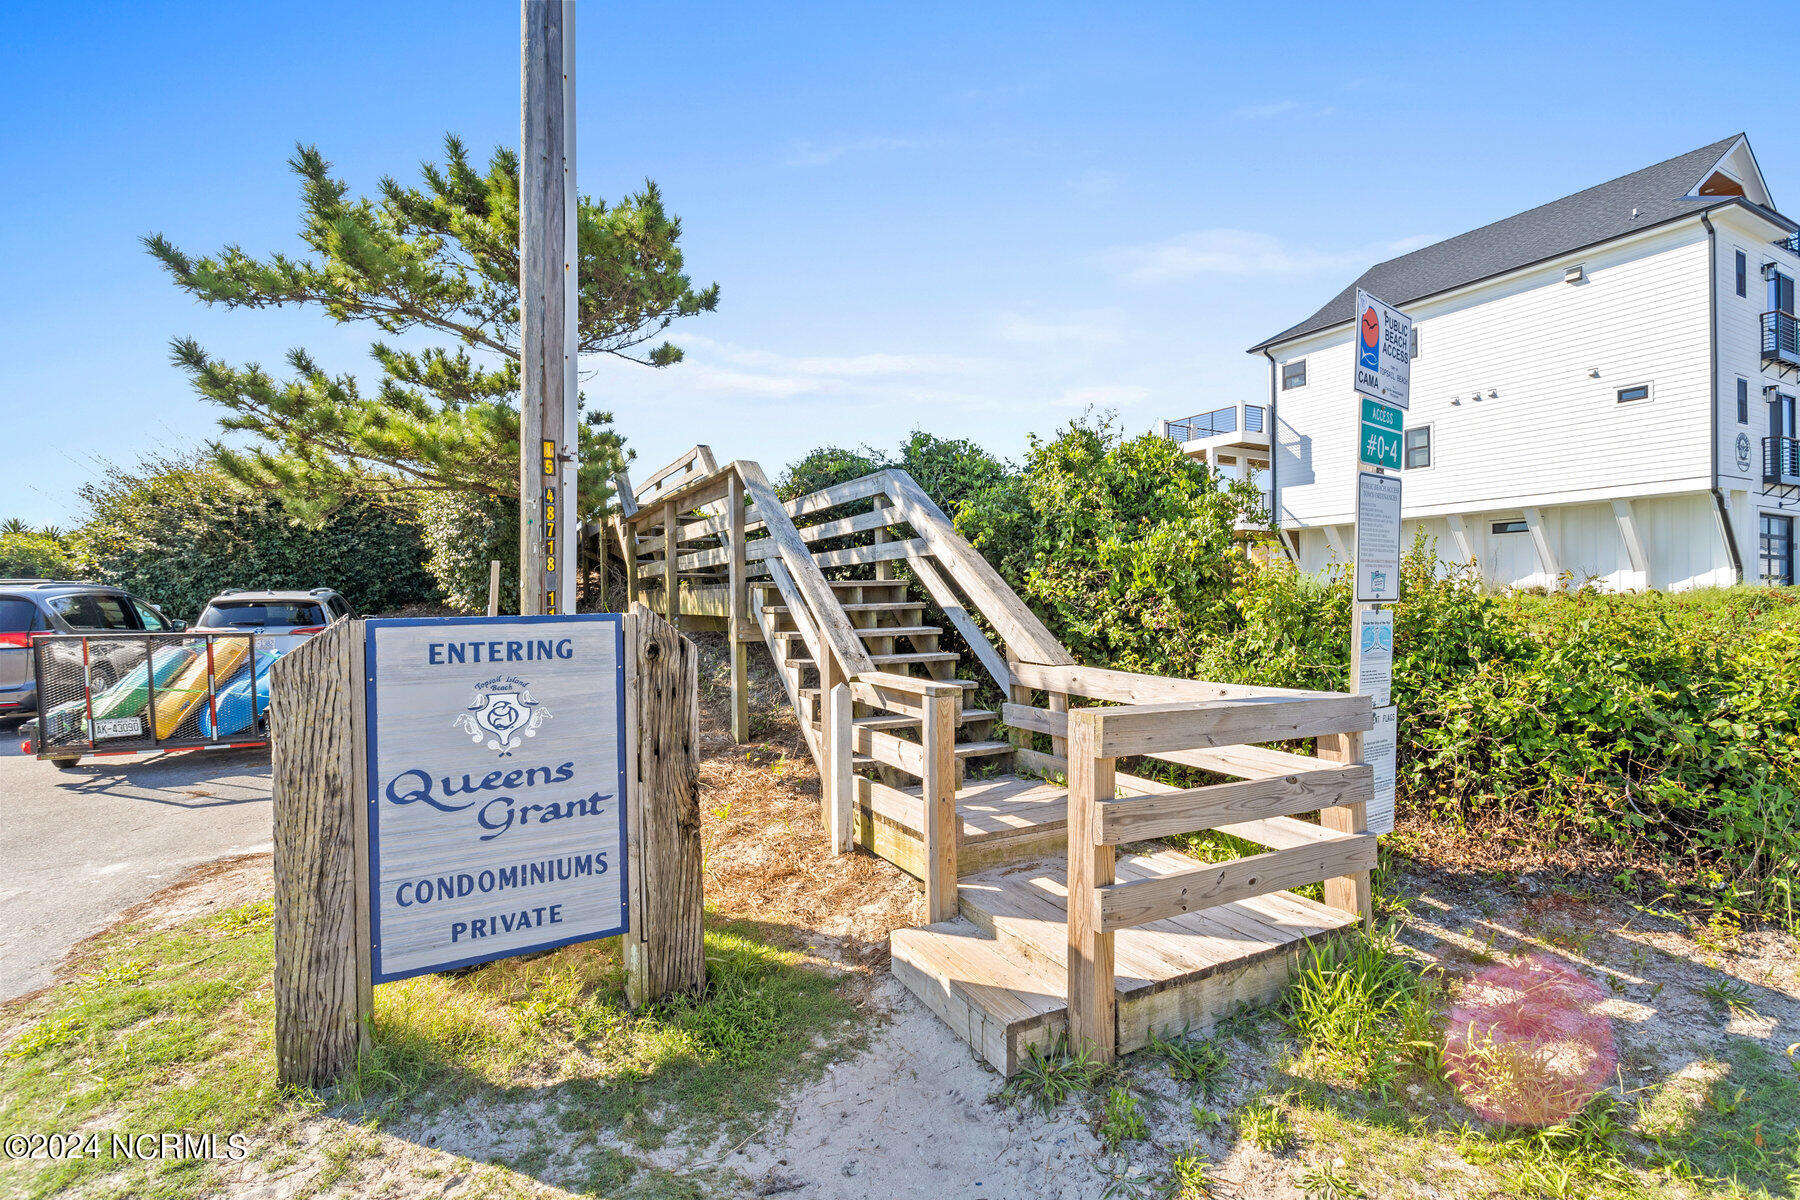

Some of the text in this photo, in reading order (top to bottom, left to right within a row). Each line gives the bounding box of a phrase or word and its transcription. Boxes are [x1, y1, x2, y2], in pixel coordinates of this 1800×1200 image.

[1384, 315, 1408, 337] PUBLIC
[1384, 328, 1408, 350] BEACH
[1382, 342, 1409, 364] ACCESS
[1358, 370, 1379, 389] CAMA
[1380, 366, 1396, 380] TOPSAIL
[1372, 407, 1394, 425] ACCESS
[1366, 433, 1398, 463] #0-4
[546, 488, 555, 572] 48718
[428, 638, 574, 664] ENTERING
[474, 675, 530, 690] Topsail Island
[96, 722, 140, 735] AK-43090
[385, 761, 575, 812] Queens
[477, 792, 614, 841] Grant
[395, 851, 608, 908] CONDOMINIUMS
[451, 904, 563, 943] PRIVATE
